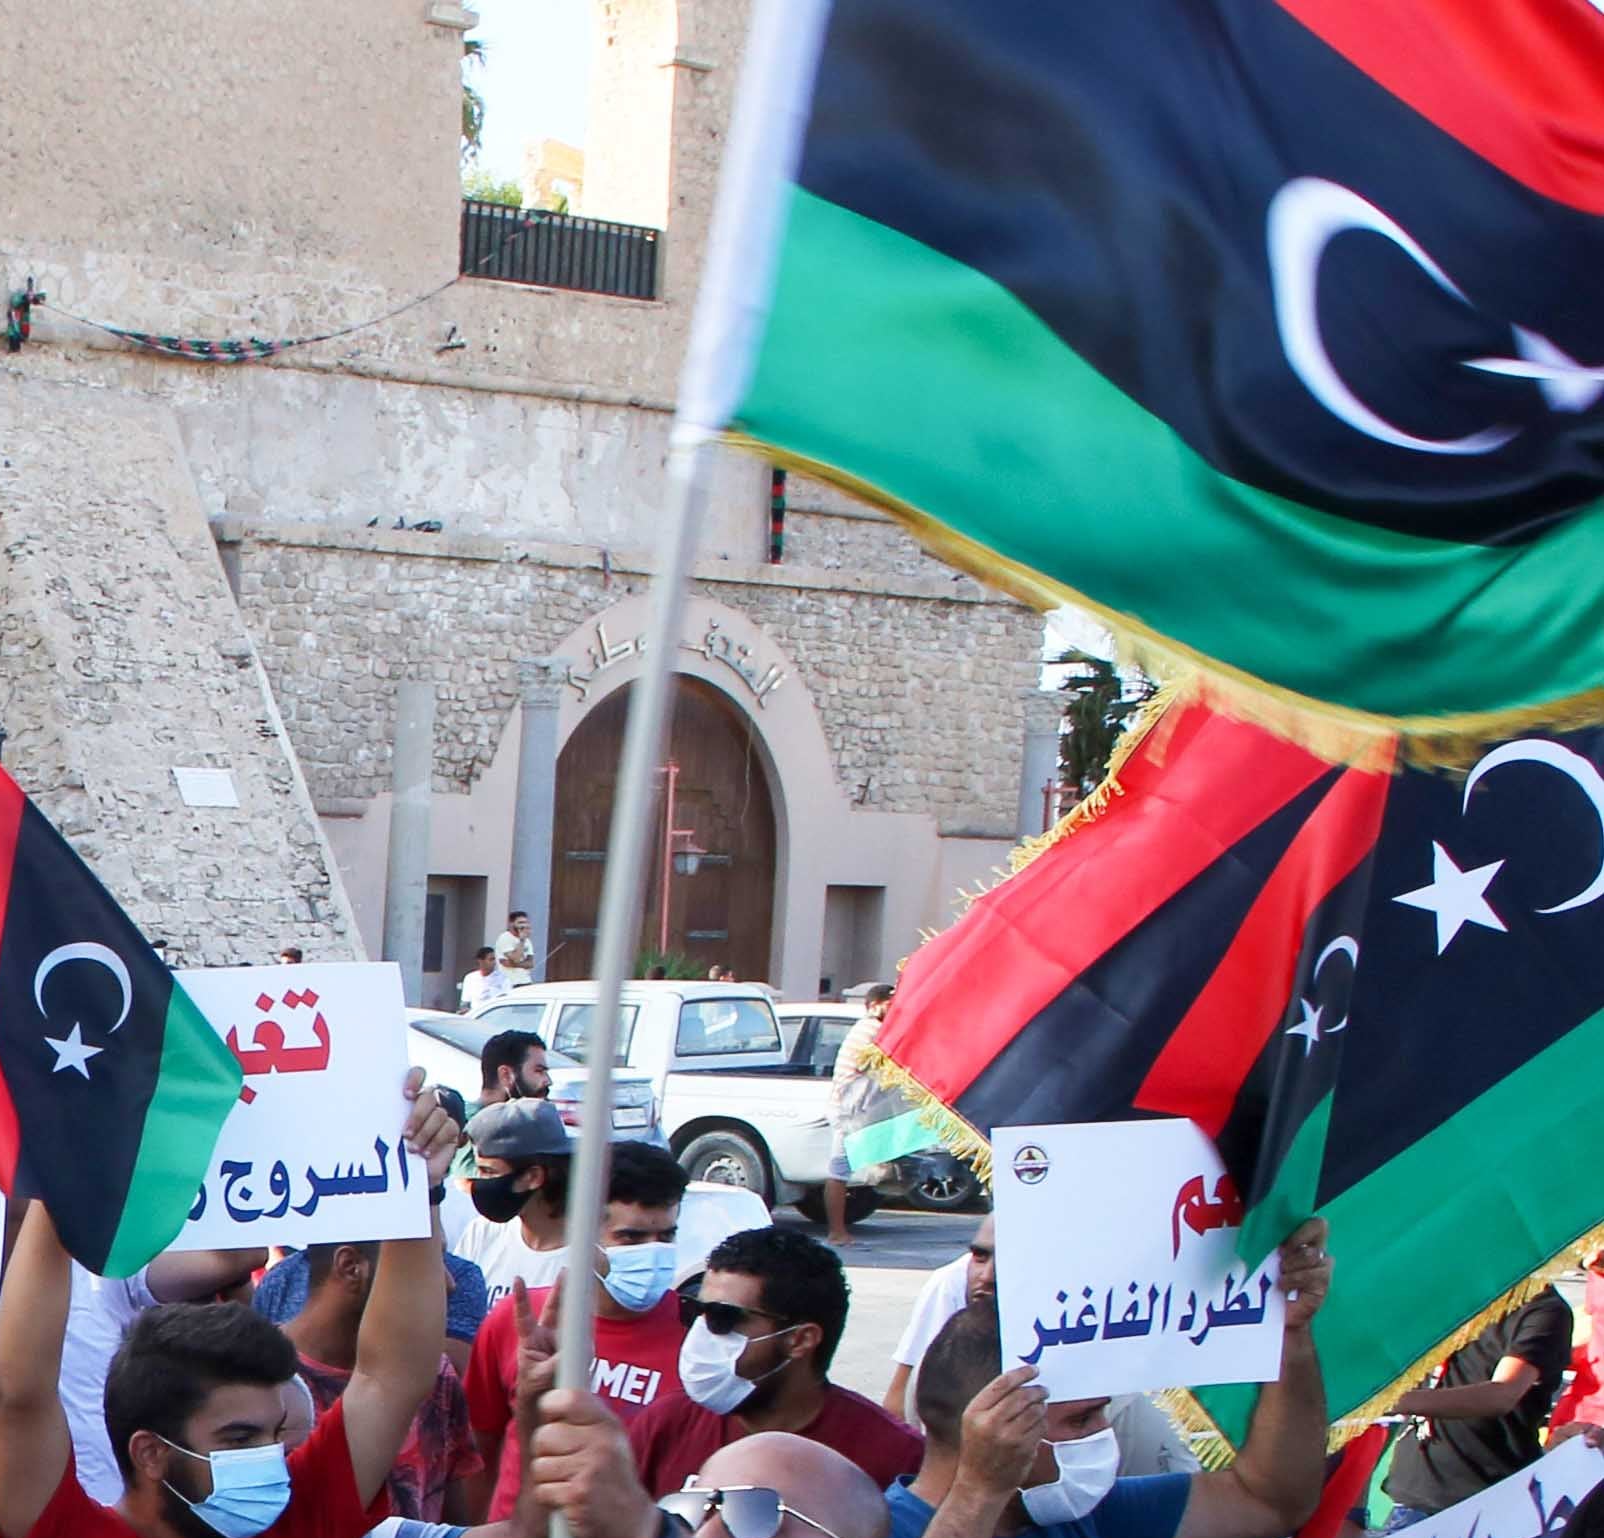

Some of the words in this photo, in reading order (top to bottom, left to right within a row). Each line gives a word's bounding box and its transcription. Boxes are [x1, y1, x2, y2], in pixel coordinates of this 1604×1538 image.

[218, 1133, 409, 1223] السروج
[1017, 1280, 1173, 1367] الفاغنر
[1178, 1271, 1273, 1347] لطرد
